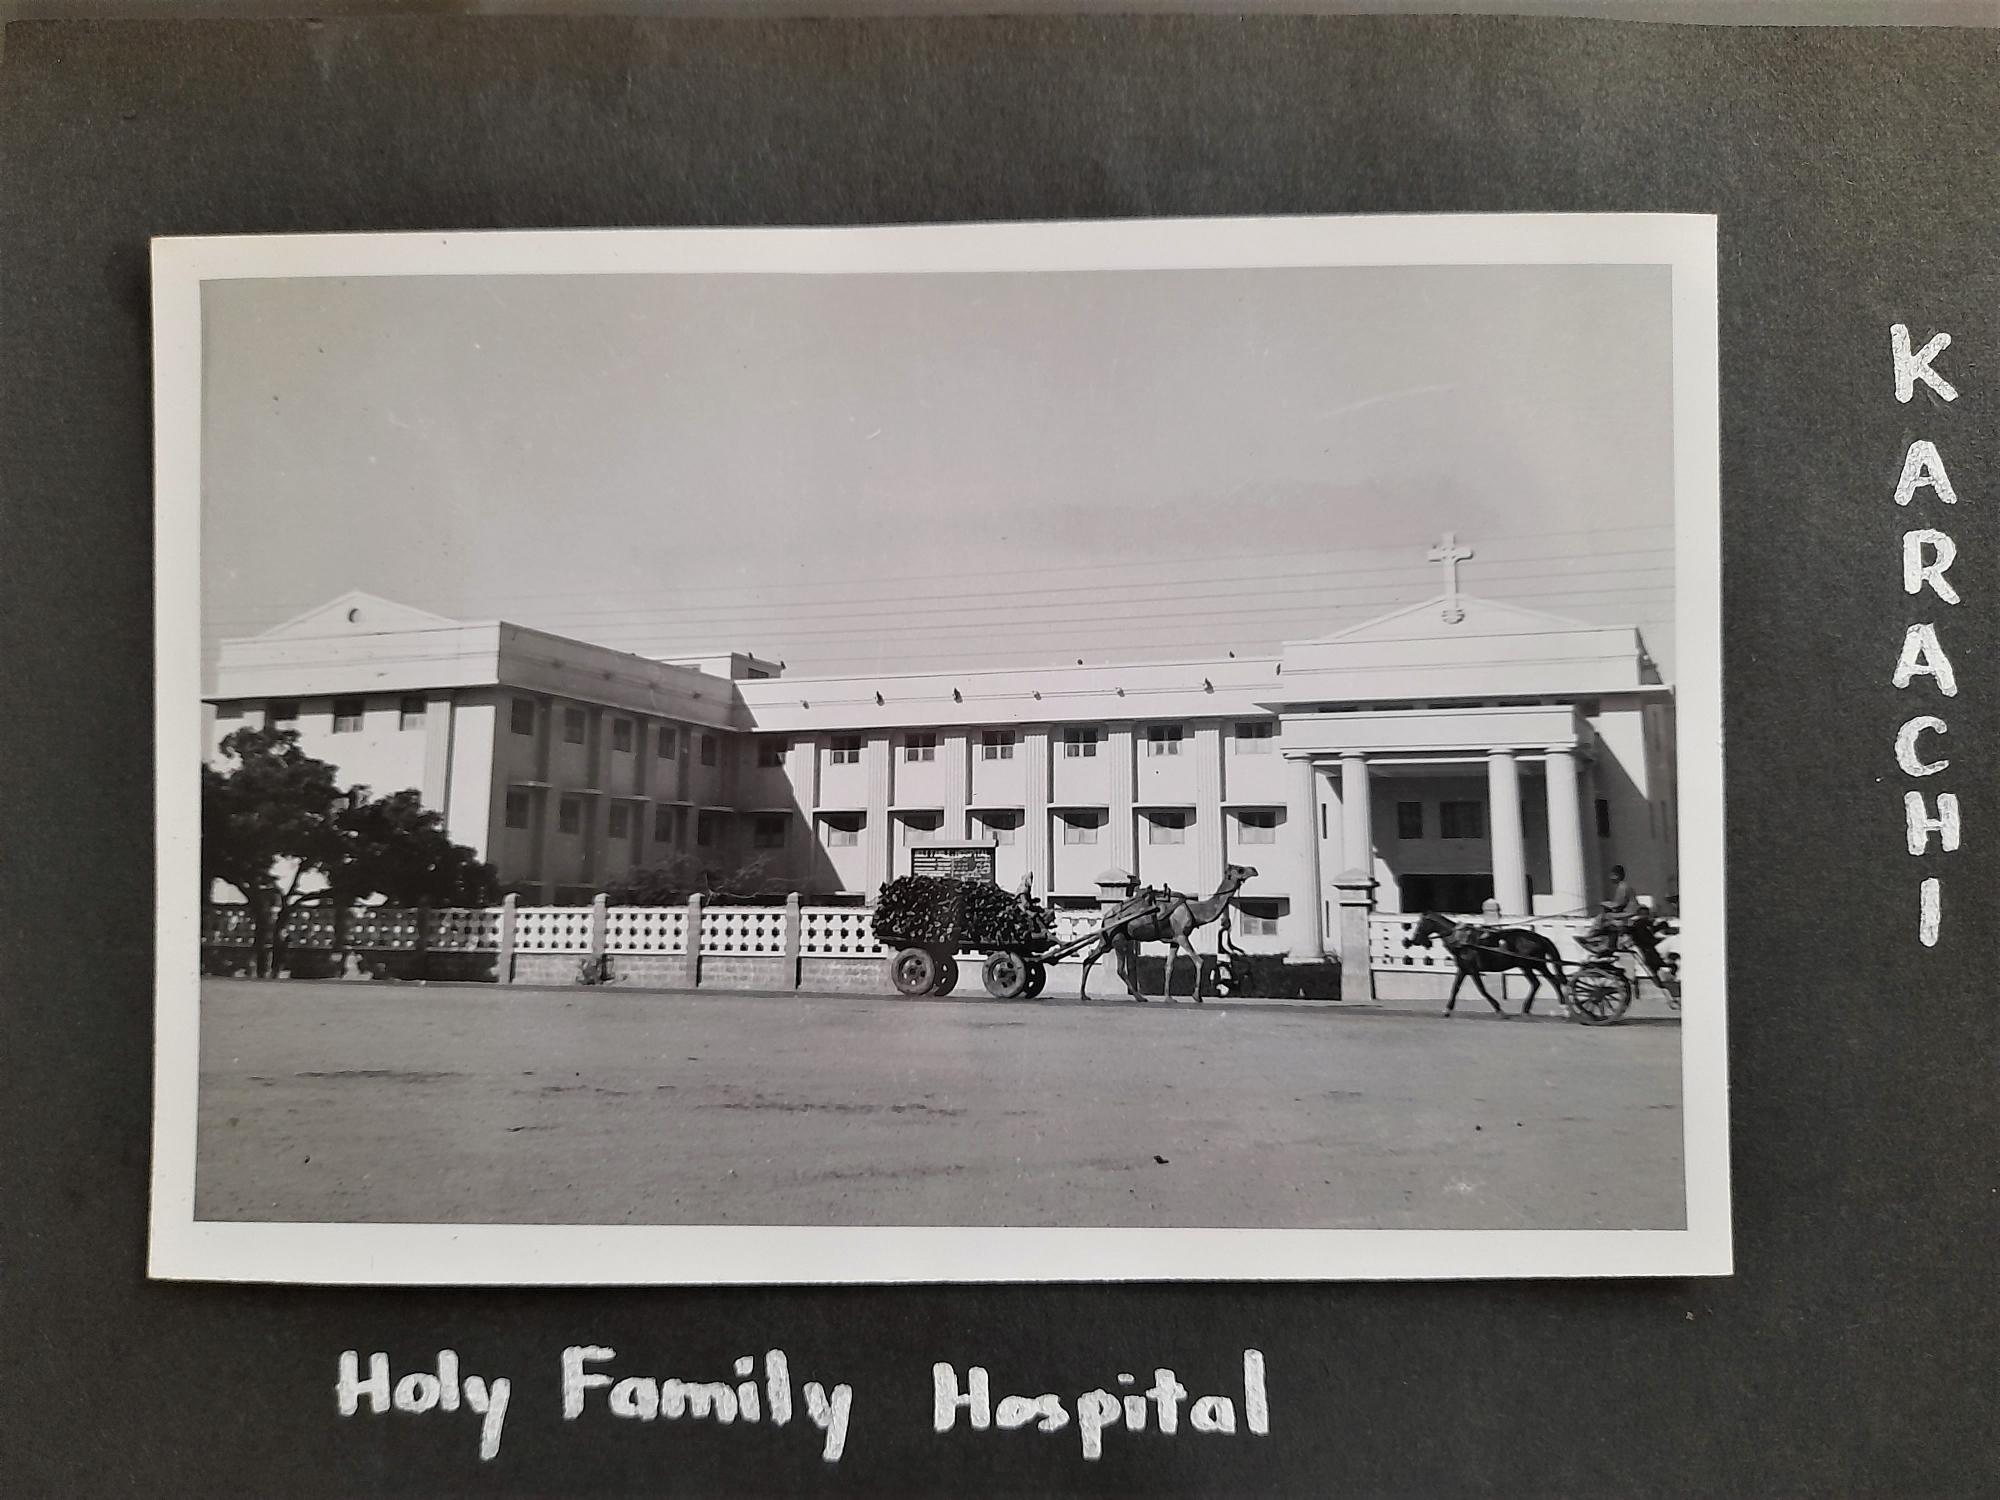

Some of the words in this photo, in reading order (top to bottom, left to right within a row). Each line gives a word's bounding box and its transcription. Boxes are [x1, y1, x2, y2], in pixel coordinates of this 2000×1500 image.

[1890, 323, 1961, 947] KARACHI
[336, 1349, 511, 1460] Holy
[562, 1345, 853, 1461] Family
[933, 1348, 1269, 1460] Hospital
